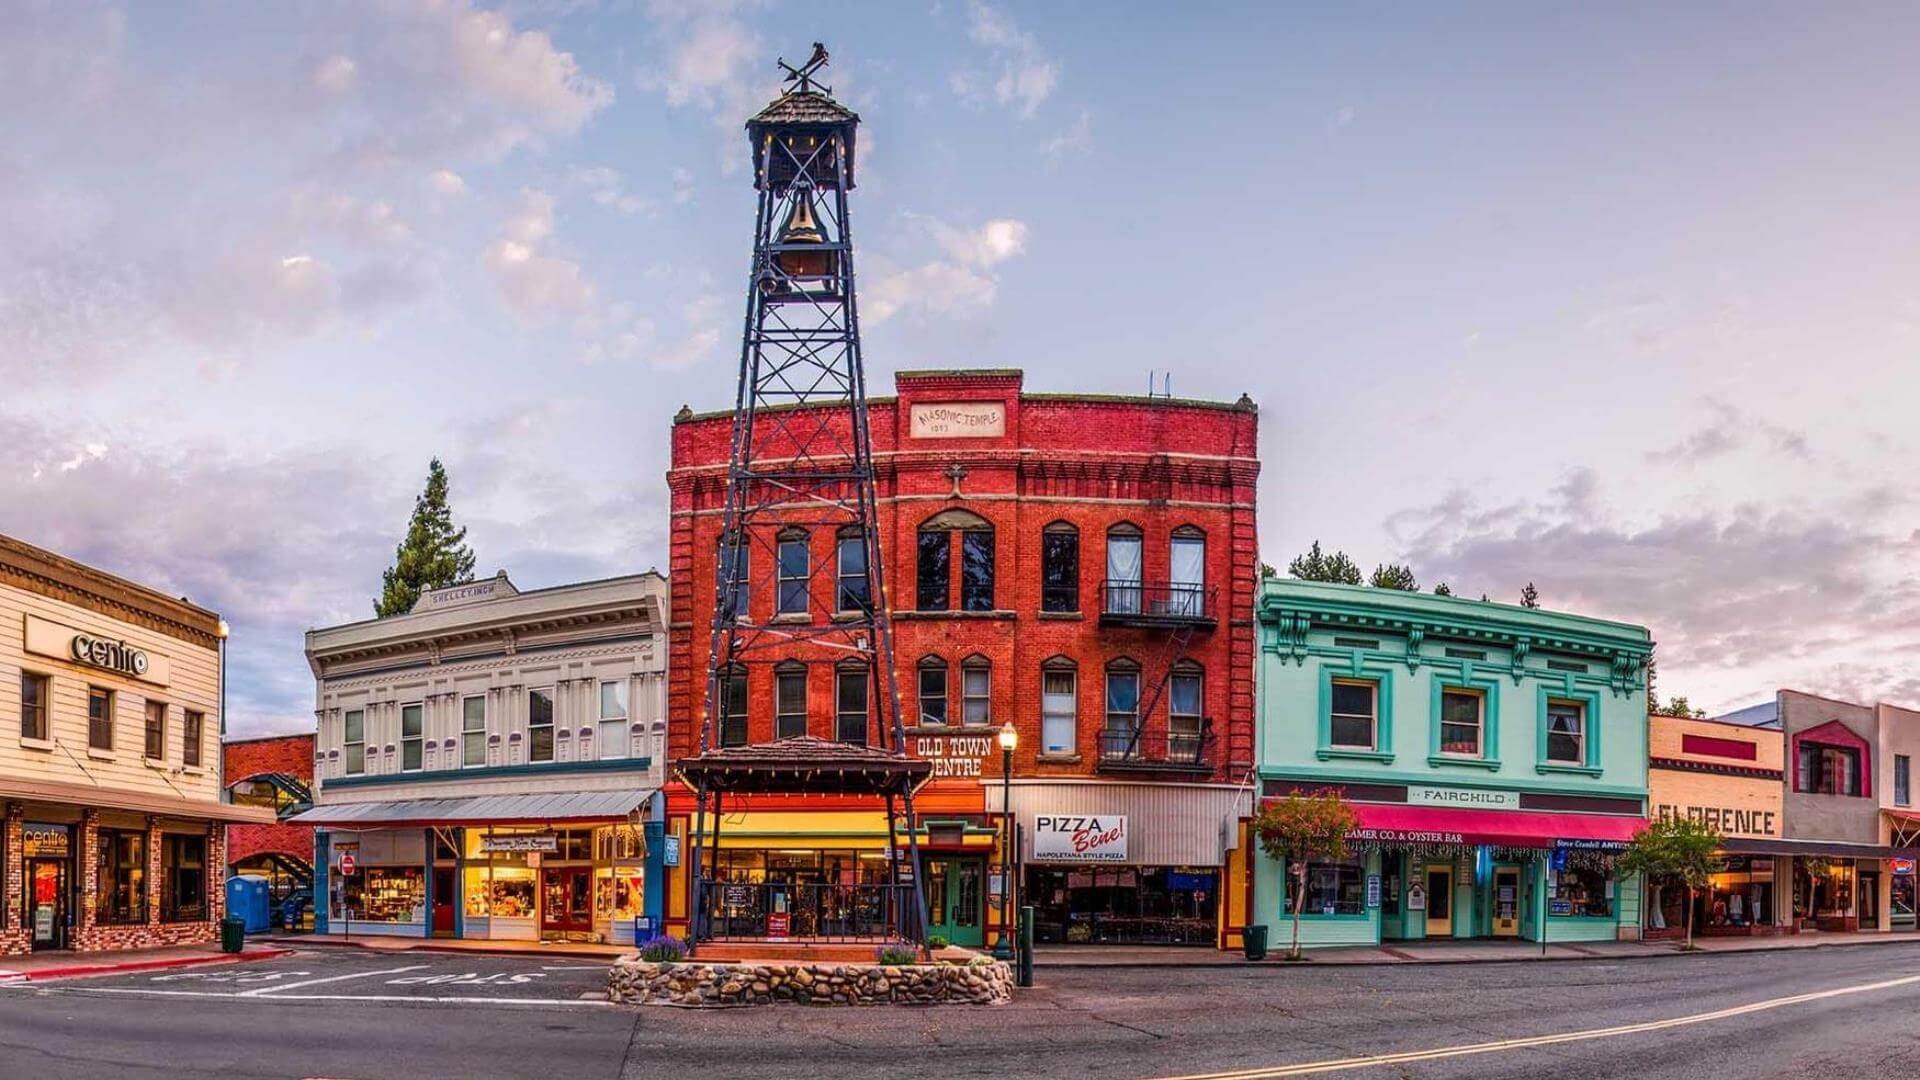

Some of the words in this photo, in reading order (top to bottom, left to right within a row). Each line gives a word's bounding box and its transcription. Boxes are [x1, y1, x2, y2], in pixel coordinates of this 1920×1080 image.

[919, 409, 963, 425] MASONIC
[964, 411, 999, 426] TEMPLE
[72, 634, 148, 675] centro
[917, 738, 943, 756] OLD
[950, 738, 992, 756] TOWN
[1424, 790, 1505, 804] FAIRCHILD
[1037, 817, 1102, 833] PIZZA
[1072, 817, 1124, 852] Bene!
[1379, 831, 1397, 841] CO.
[1399, 833, 1406, 841] &
[1407, 831, 1443, 843] OYSTER
[1445, 833, 1463, 843] BAR
